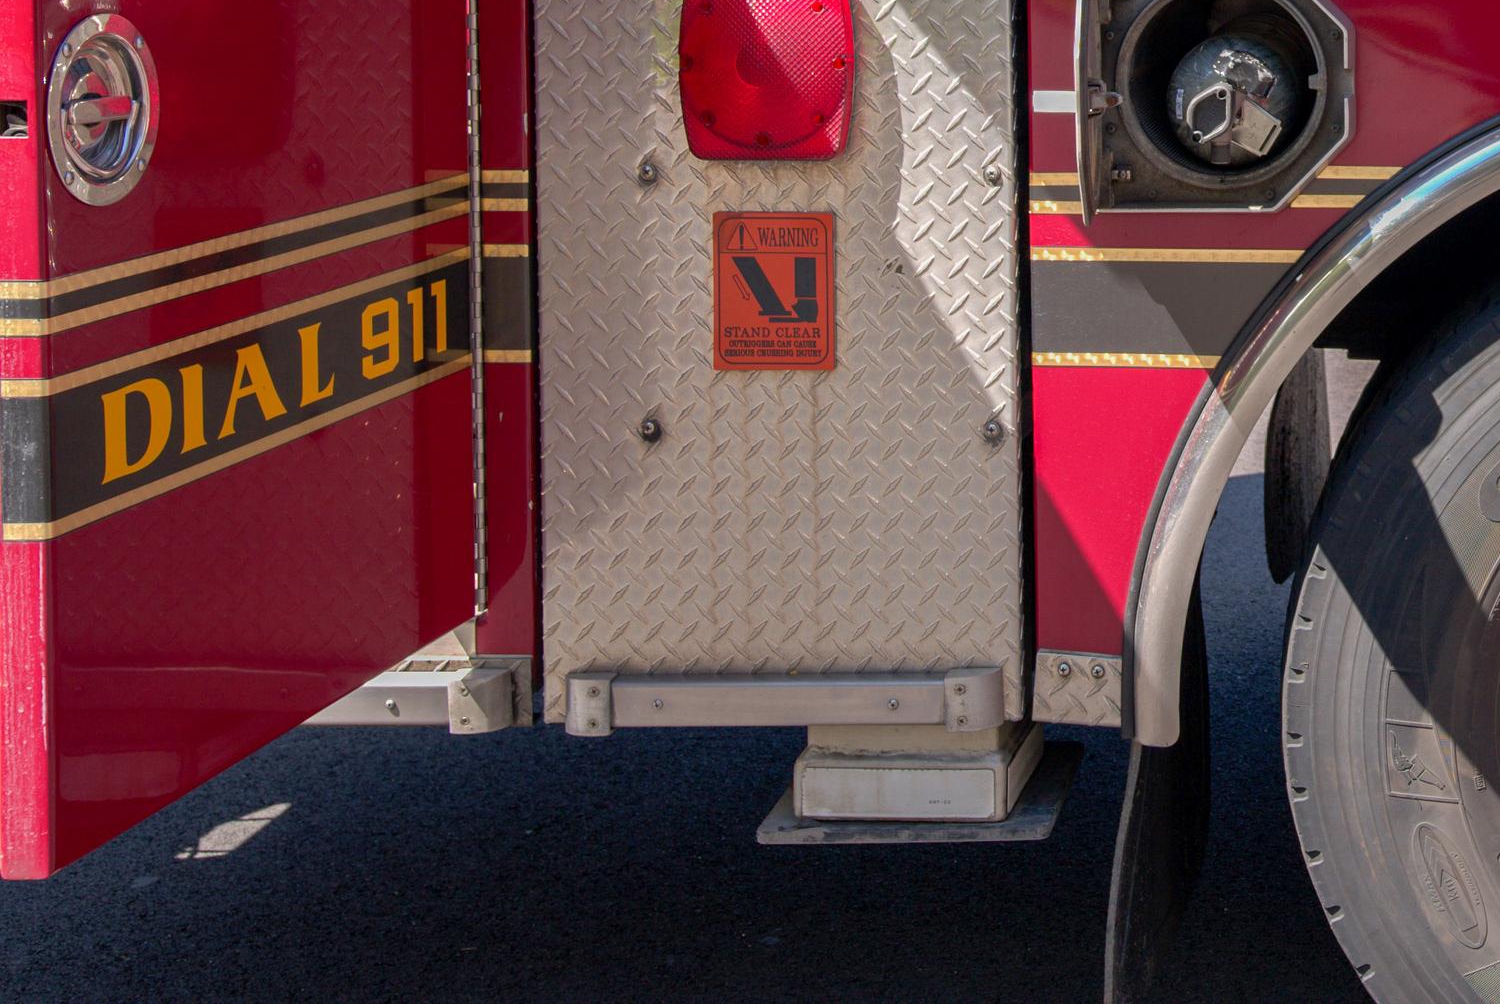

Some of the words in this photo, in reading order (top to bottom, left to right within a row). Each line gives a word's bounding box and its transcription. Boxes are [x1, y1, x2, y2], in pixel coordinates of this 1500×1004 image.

[757, 227, 819, 248] WARNING
[724, 326, 770, 339] STAND
[775, 326, 822, 339] CLEAR
[101, 322, 336, 485] DIAL
[361, 278, 447, 381] 911
